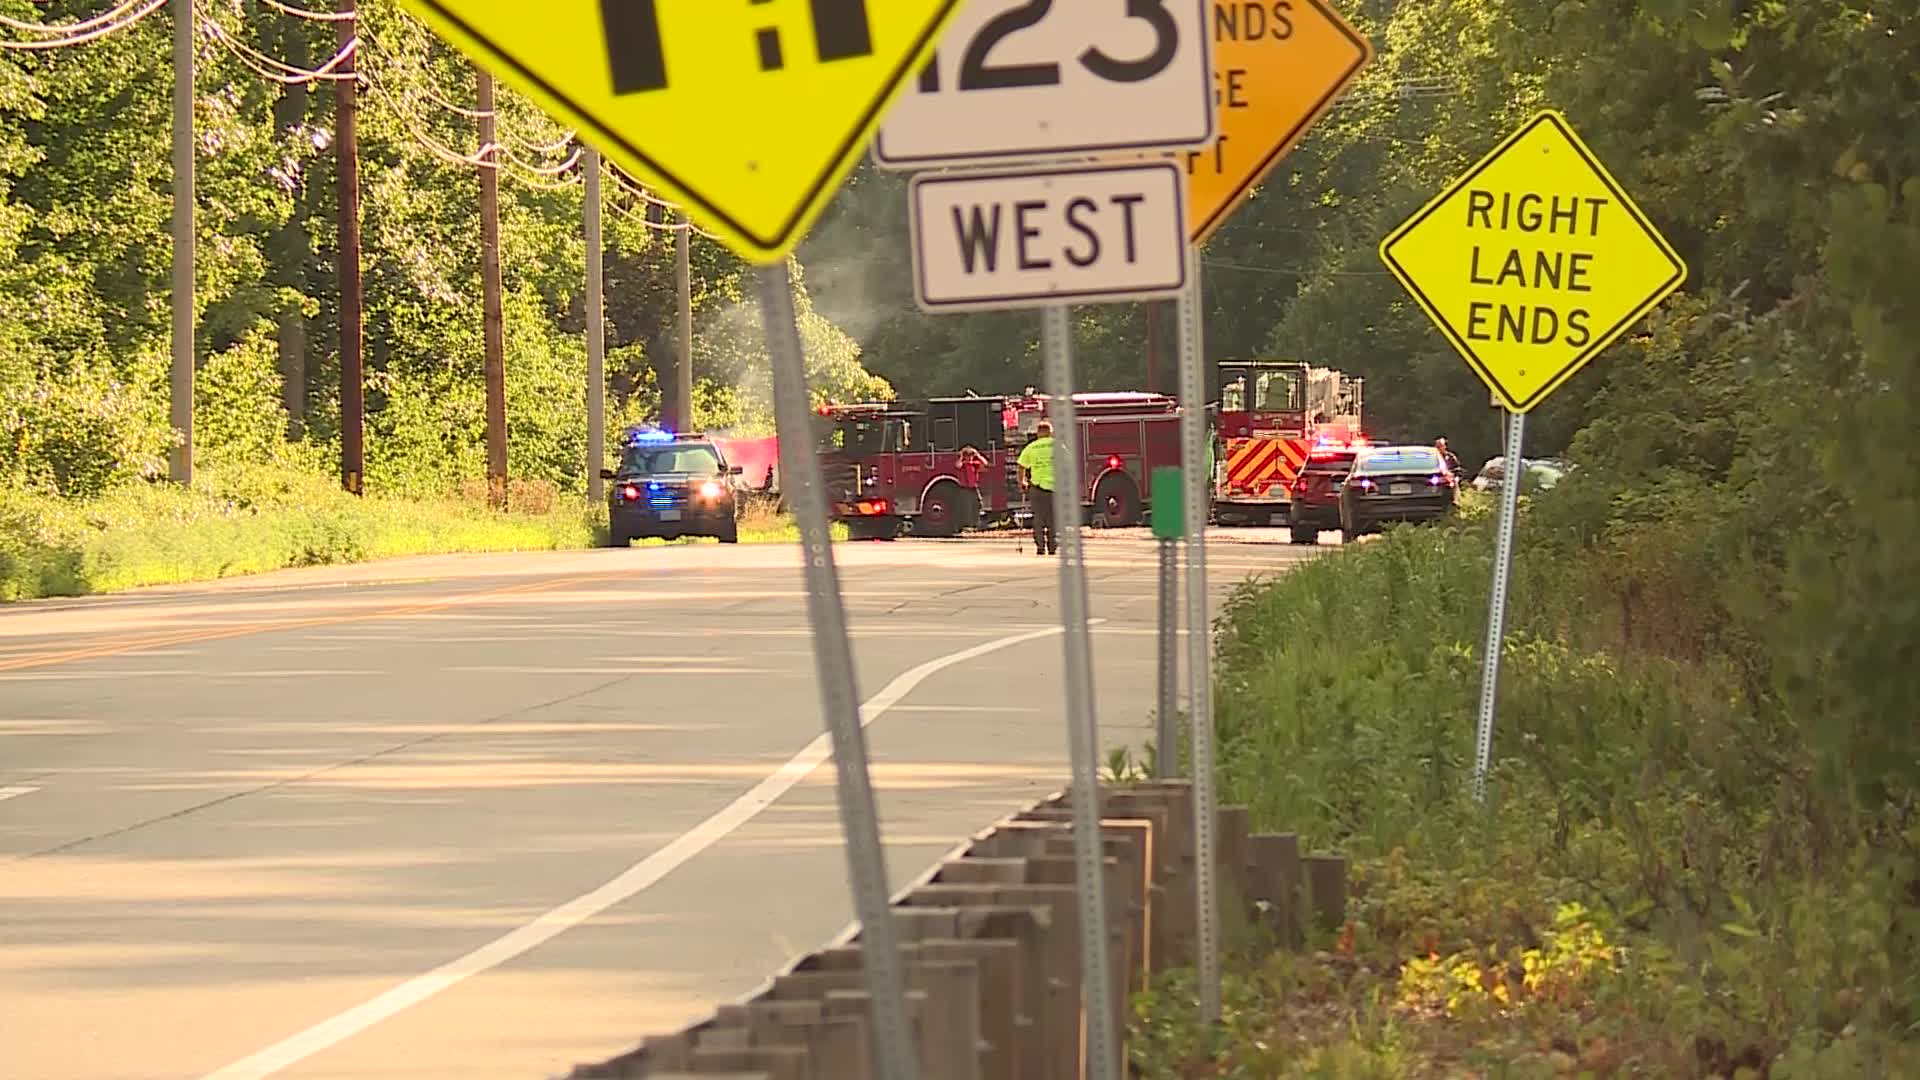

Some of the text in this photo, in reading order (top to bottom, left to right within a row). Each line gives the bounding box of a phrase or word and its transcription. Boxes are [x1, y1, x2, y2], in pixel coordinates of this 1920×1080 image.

[1214, 1, 1294, 41] NDS
[918, 0, 1179, 93] 23
[952, 194, 1146, 276] WEST
[1466, 190, 1608, 236] RIGHT
[1469, 246, 1593, 292] LANE
[1467, 302, 1590, 348] ENDS
